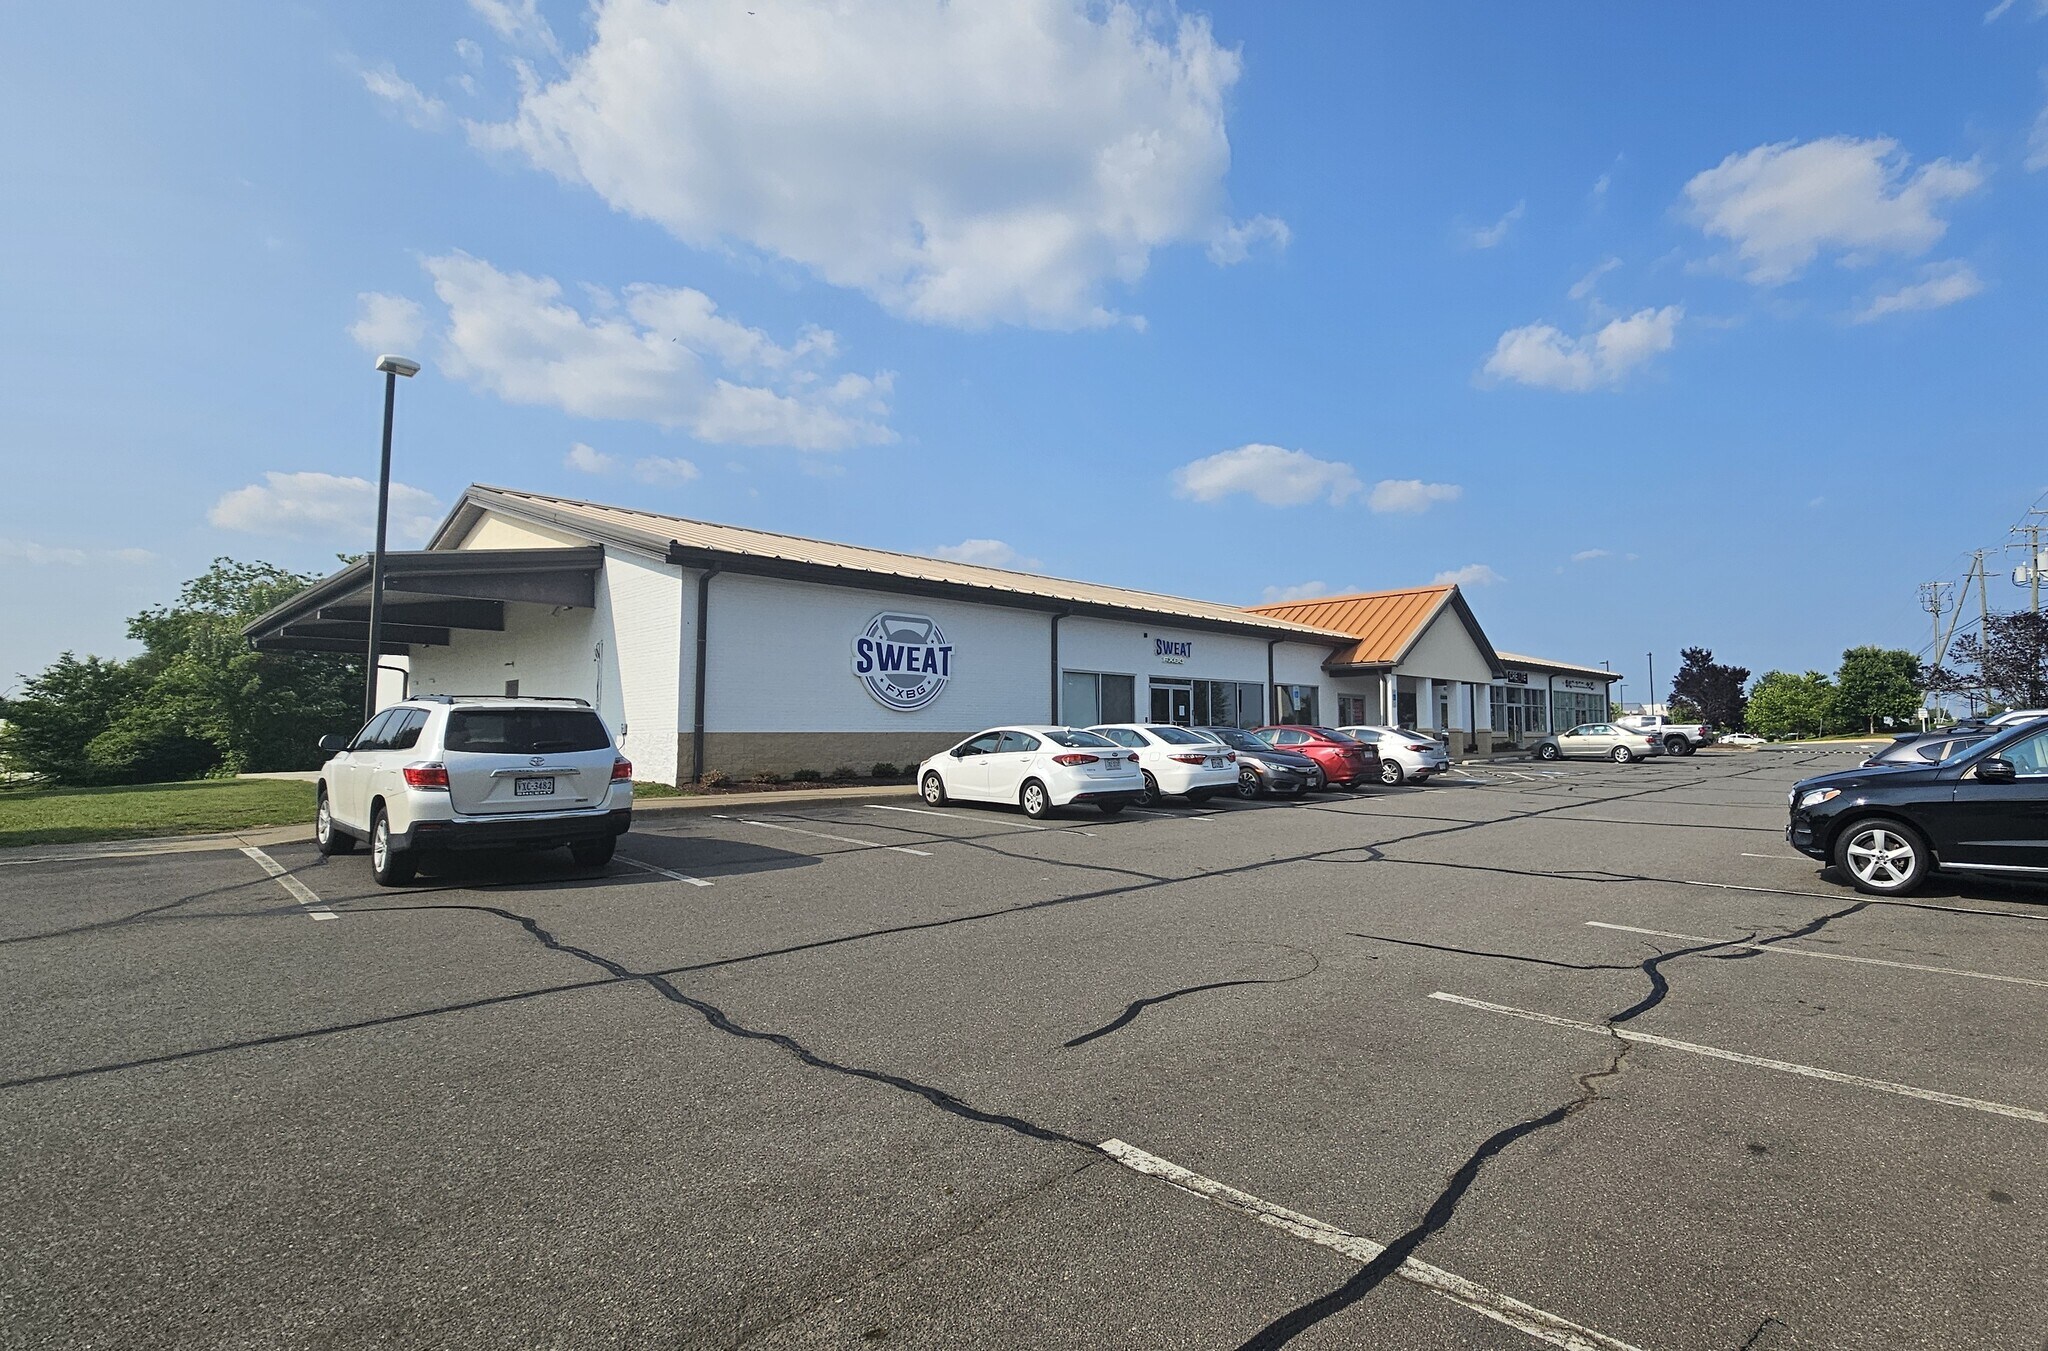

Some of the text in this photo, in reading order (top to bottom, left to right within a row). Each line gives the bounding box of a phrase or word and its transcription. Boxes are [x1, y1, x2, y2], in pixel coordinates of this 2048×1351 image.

[857, 638, 952, 676] SWEAT
[1156, 638, 1192, 657] SWEAT
[885, 684, 926, 699] FXBG
